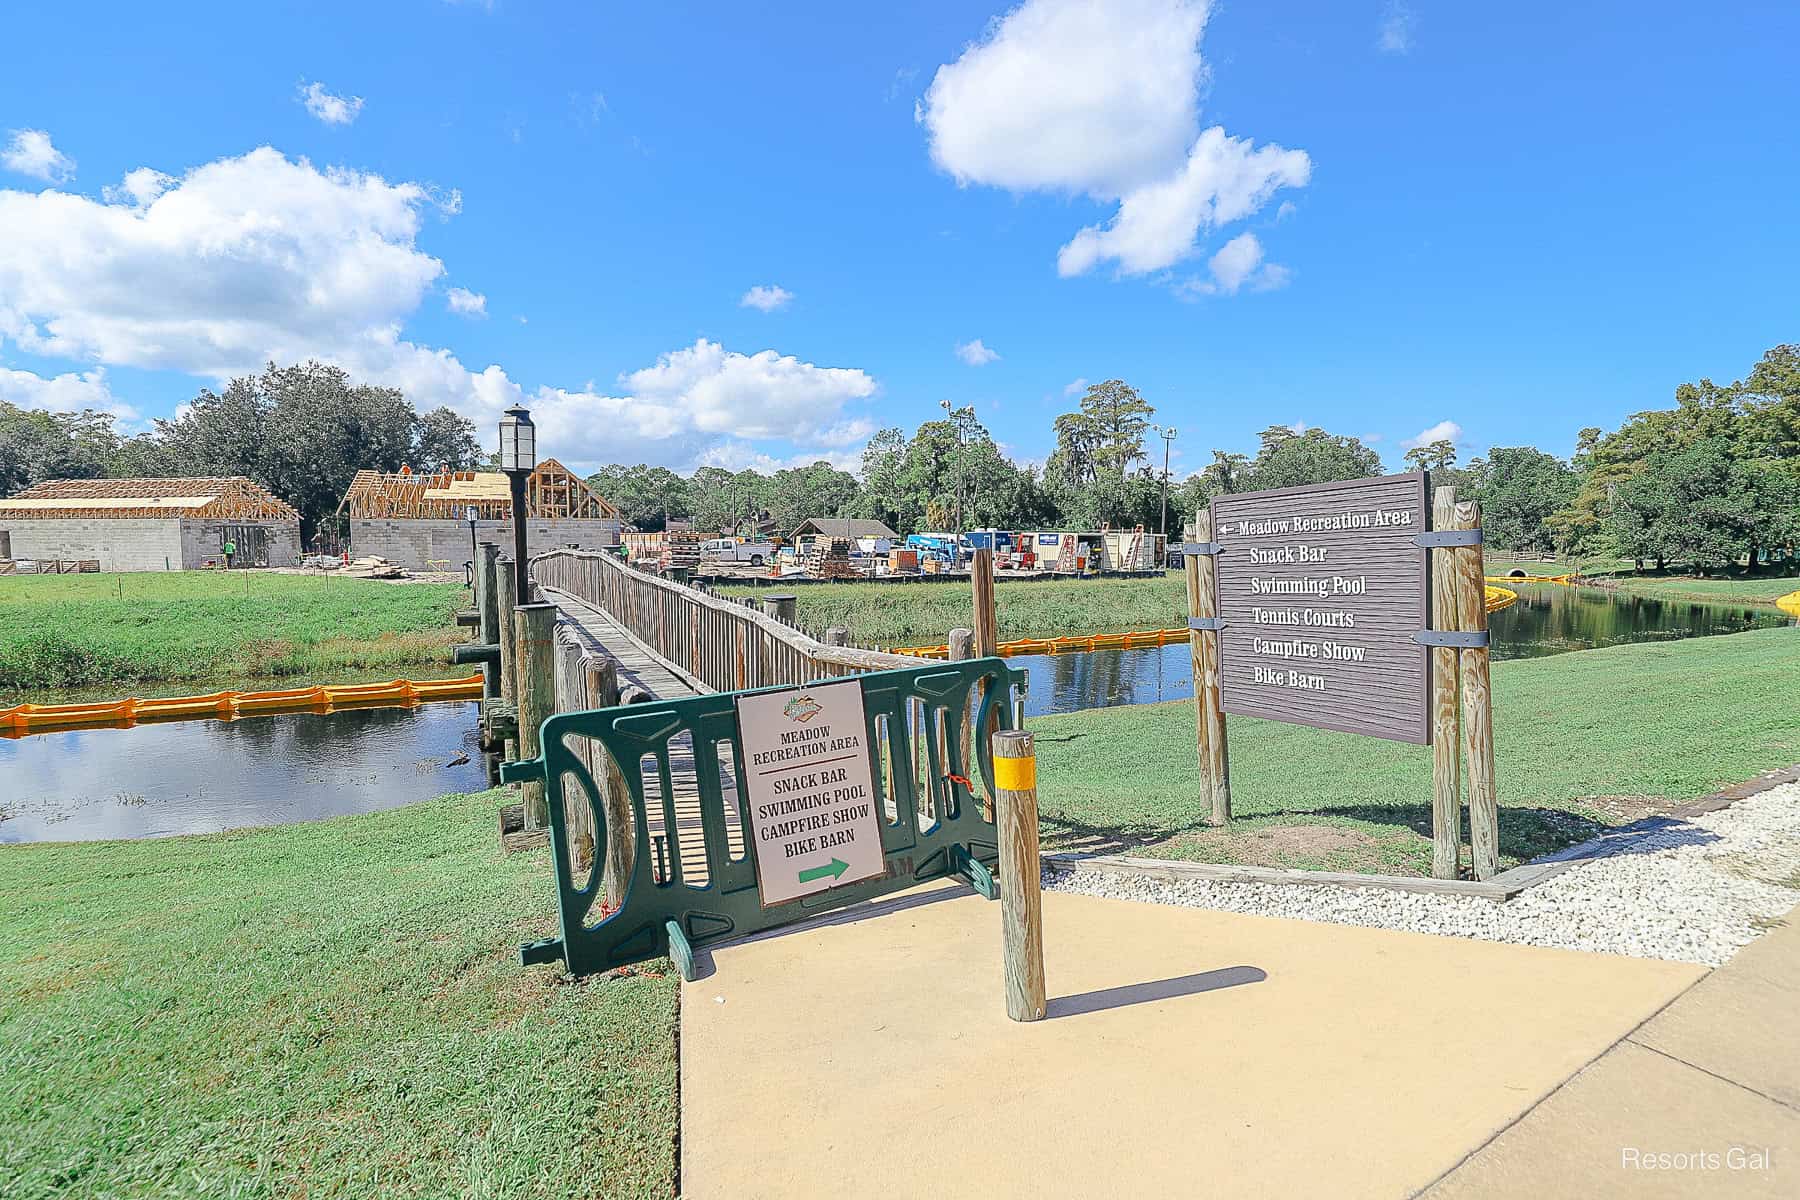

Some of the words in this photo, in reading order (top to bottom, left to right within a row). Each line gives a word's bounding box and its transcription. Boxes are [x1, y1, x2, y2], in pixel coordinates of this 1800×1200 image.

[1239, 519, 1289, 536] Meadow
[1293, 513, 1370, 532] Recreation
[1374, 509, 1412, 527] Area
[1250, 546, 1297, 564] Snack
[1299, 545, 1328, 562] Bar
[1251, 576, 1329, 598] Swimming
[1333, 576, 1367, 594] Pool
[1252, 607, 1300, 625] Tennis
[1304, 608, 1354, 627] Courts
[1253, 637, 1318, 658] Campfire
[1322, 641, 1366, 662] Show
[1254, 666, 1284, 685] Bike
[1288, 670, 1325, 690] Barn
[781, 725, 831, 745] MEADOW
[753, 741, 827, 766] RECREATION
[830, 736, 860, 752] AREA
[773, 774, 818, 795] SNACK
[822, 768, 848, 785] BAR
[758, 791, 831, 819] SWIMMING
[834, 785, 867, 804] POOL
[760, 812, 830, 841] CAMPFIRE
[832, 804, 870, 824] SHOW
[784, 838, 817, 858] BIKE
[820, 828, 855, 848] BARN
